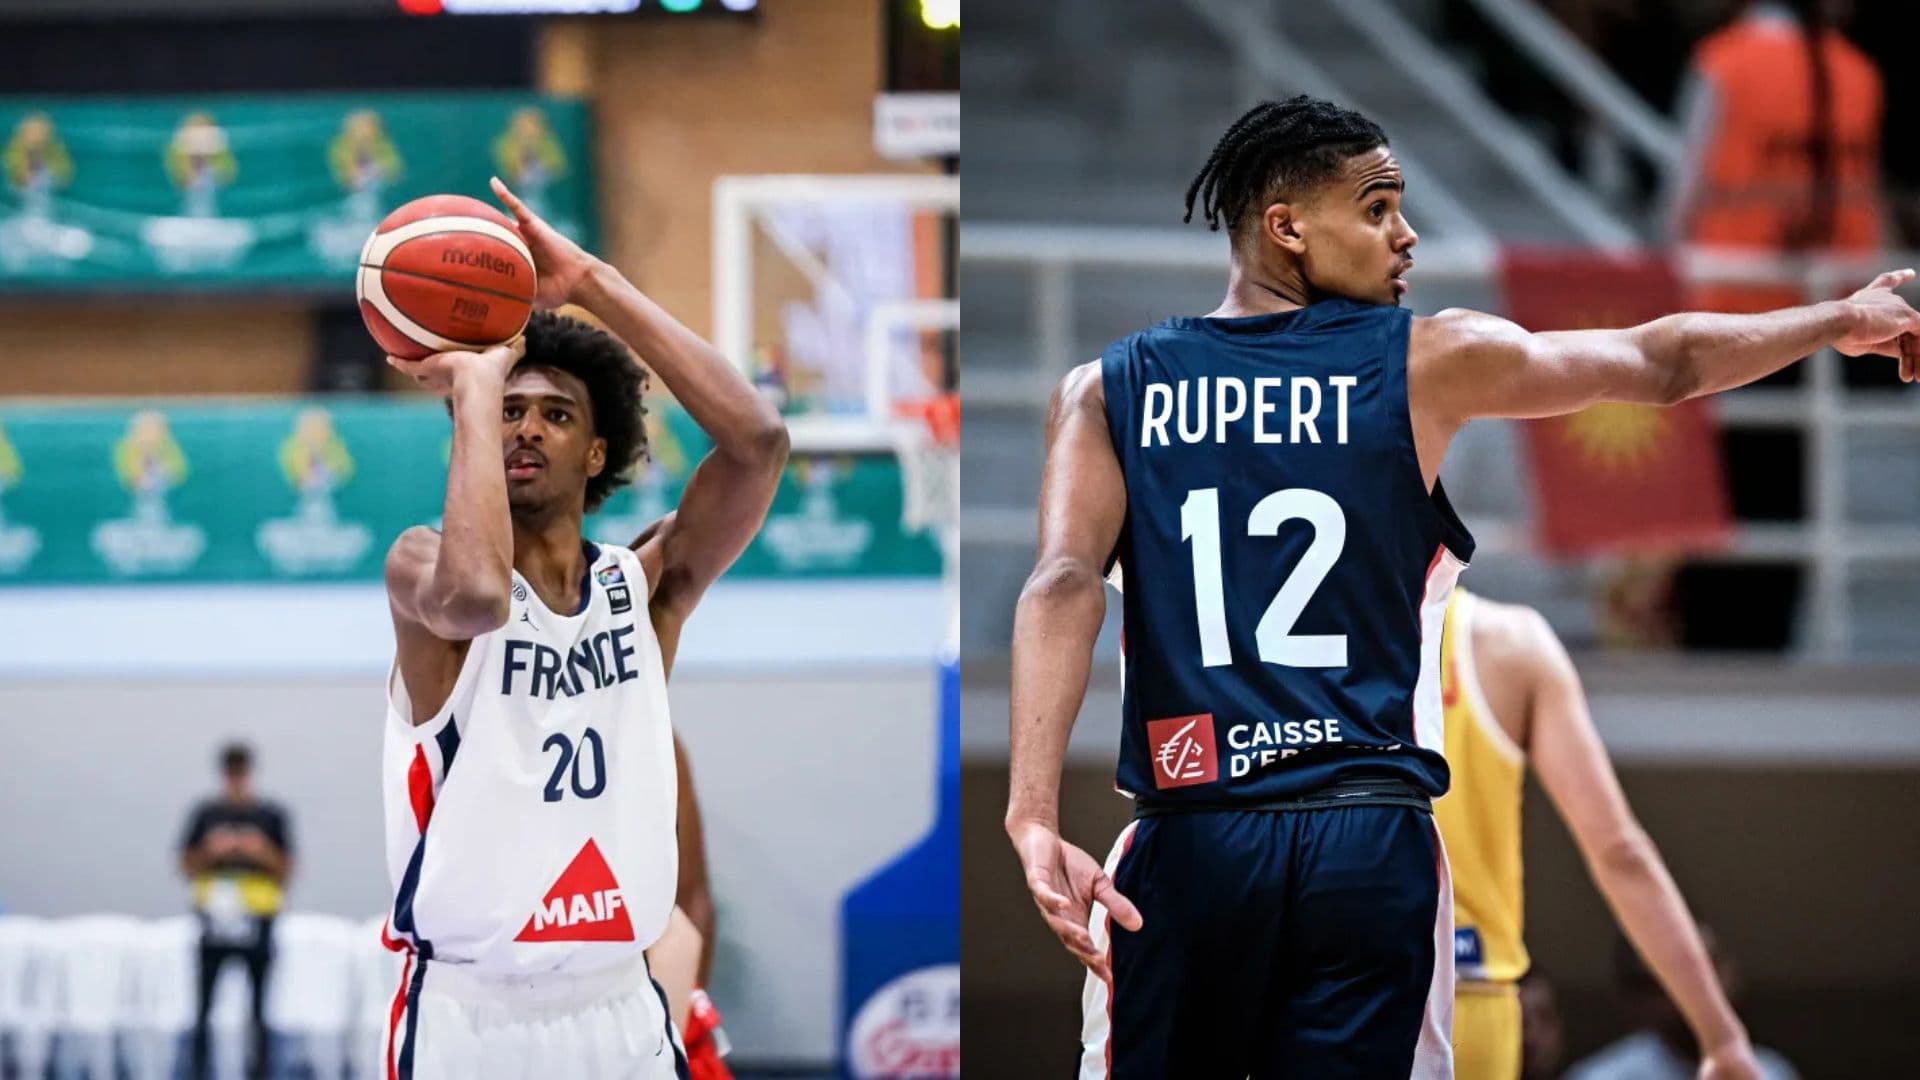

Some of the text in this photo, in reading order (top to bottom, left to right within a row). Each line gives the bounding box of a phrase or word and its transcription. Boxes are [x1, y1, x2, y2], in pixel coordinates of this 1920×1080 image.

[442, 249, 515, 277] molten
[1141, 376, 1357, 447] RUPERT
[1180, 487, 1348, 667] 12
[501, 624, 639, 700] FRANCE
[542, 727, 607, 802] 20
[1227, 719, 1342, 749] CAISSE
[534, 888, 623, 932] MAIF
